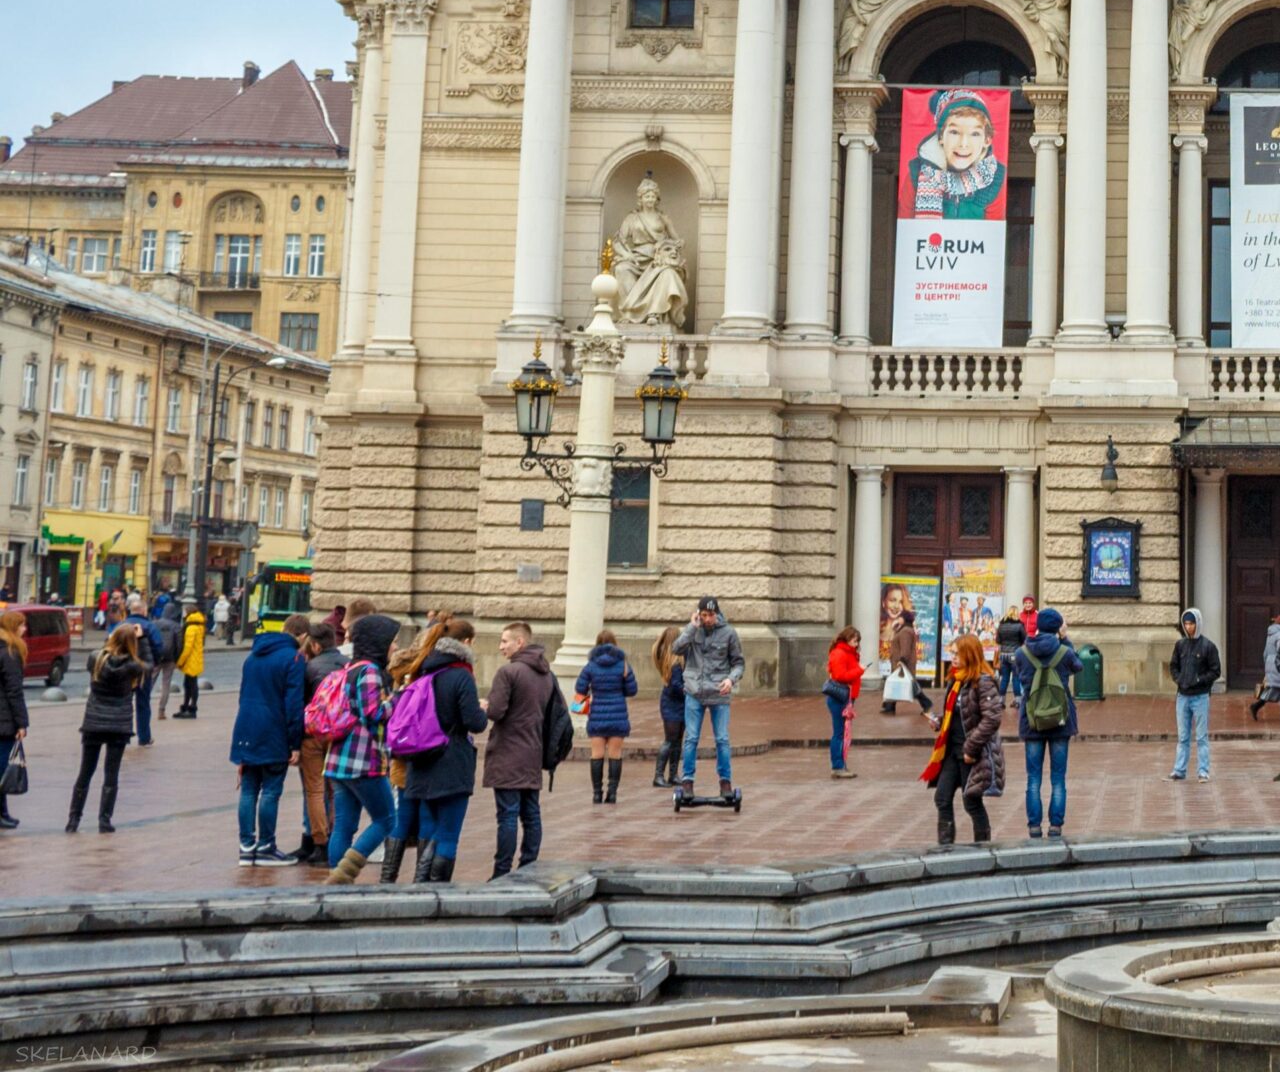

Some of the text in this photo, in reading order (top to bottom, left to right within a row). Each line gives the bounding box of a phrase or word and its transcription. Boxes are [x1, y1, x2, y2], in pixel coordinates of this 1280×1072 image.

[1243, 232, 1258, 246] in
[915, 256, 959, 270] LVIV
[1243, 253, 1261, 272] of
[915, 282, 988, 291] ЗУСТРІНЕМОСЯ
[915, 293, 921, 301] В
